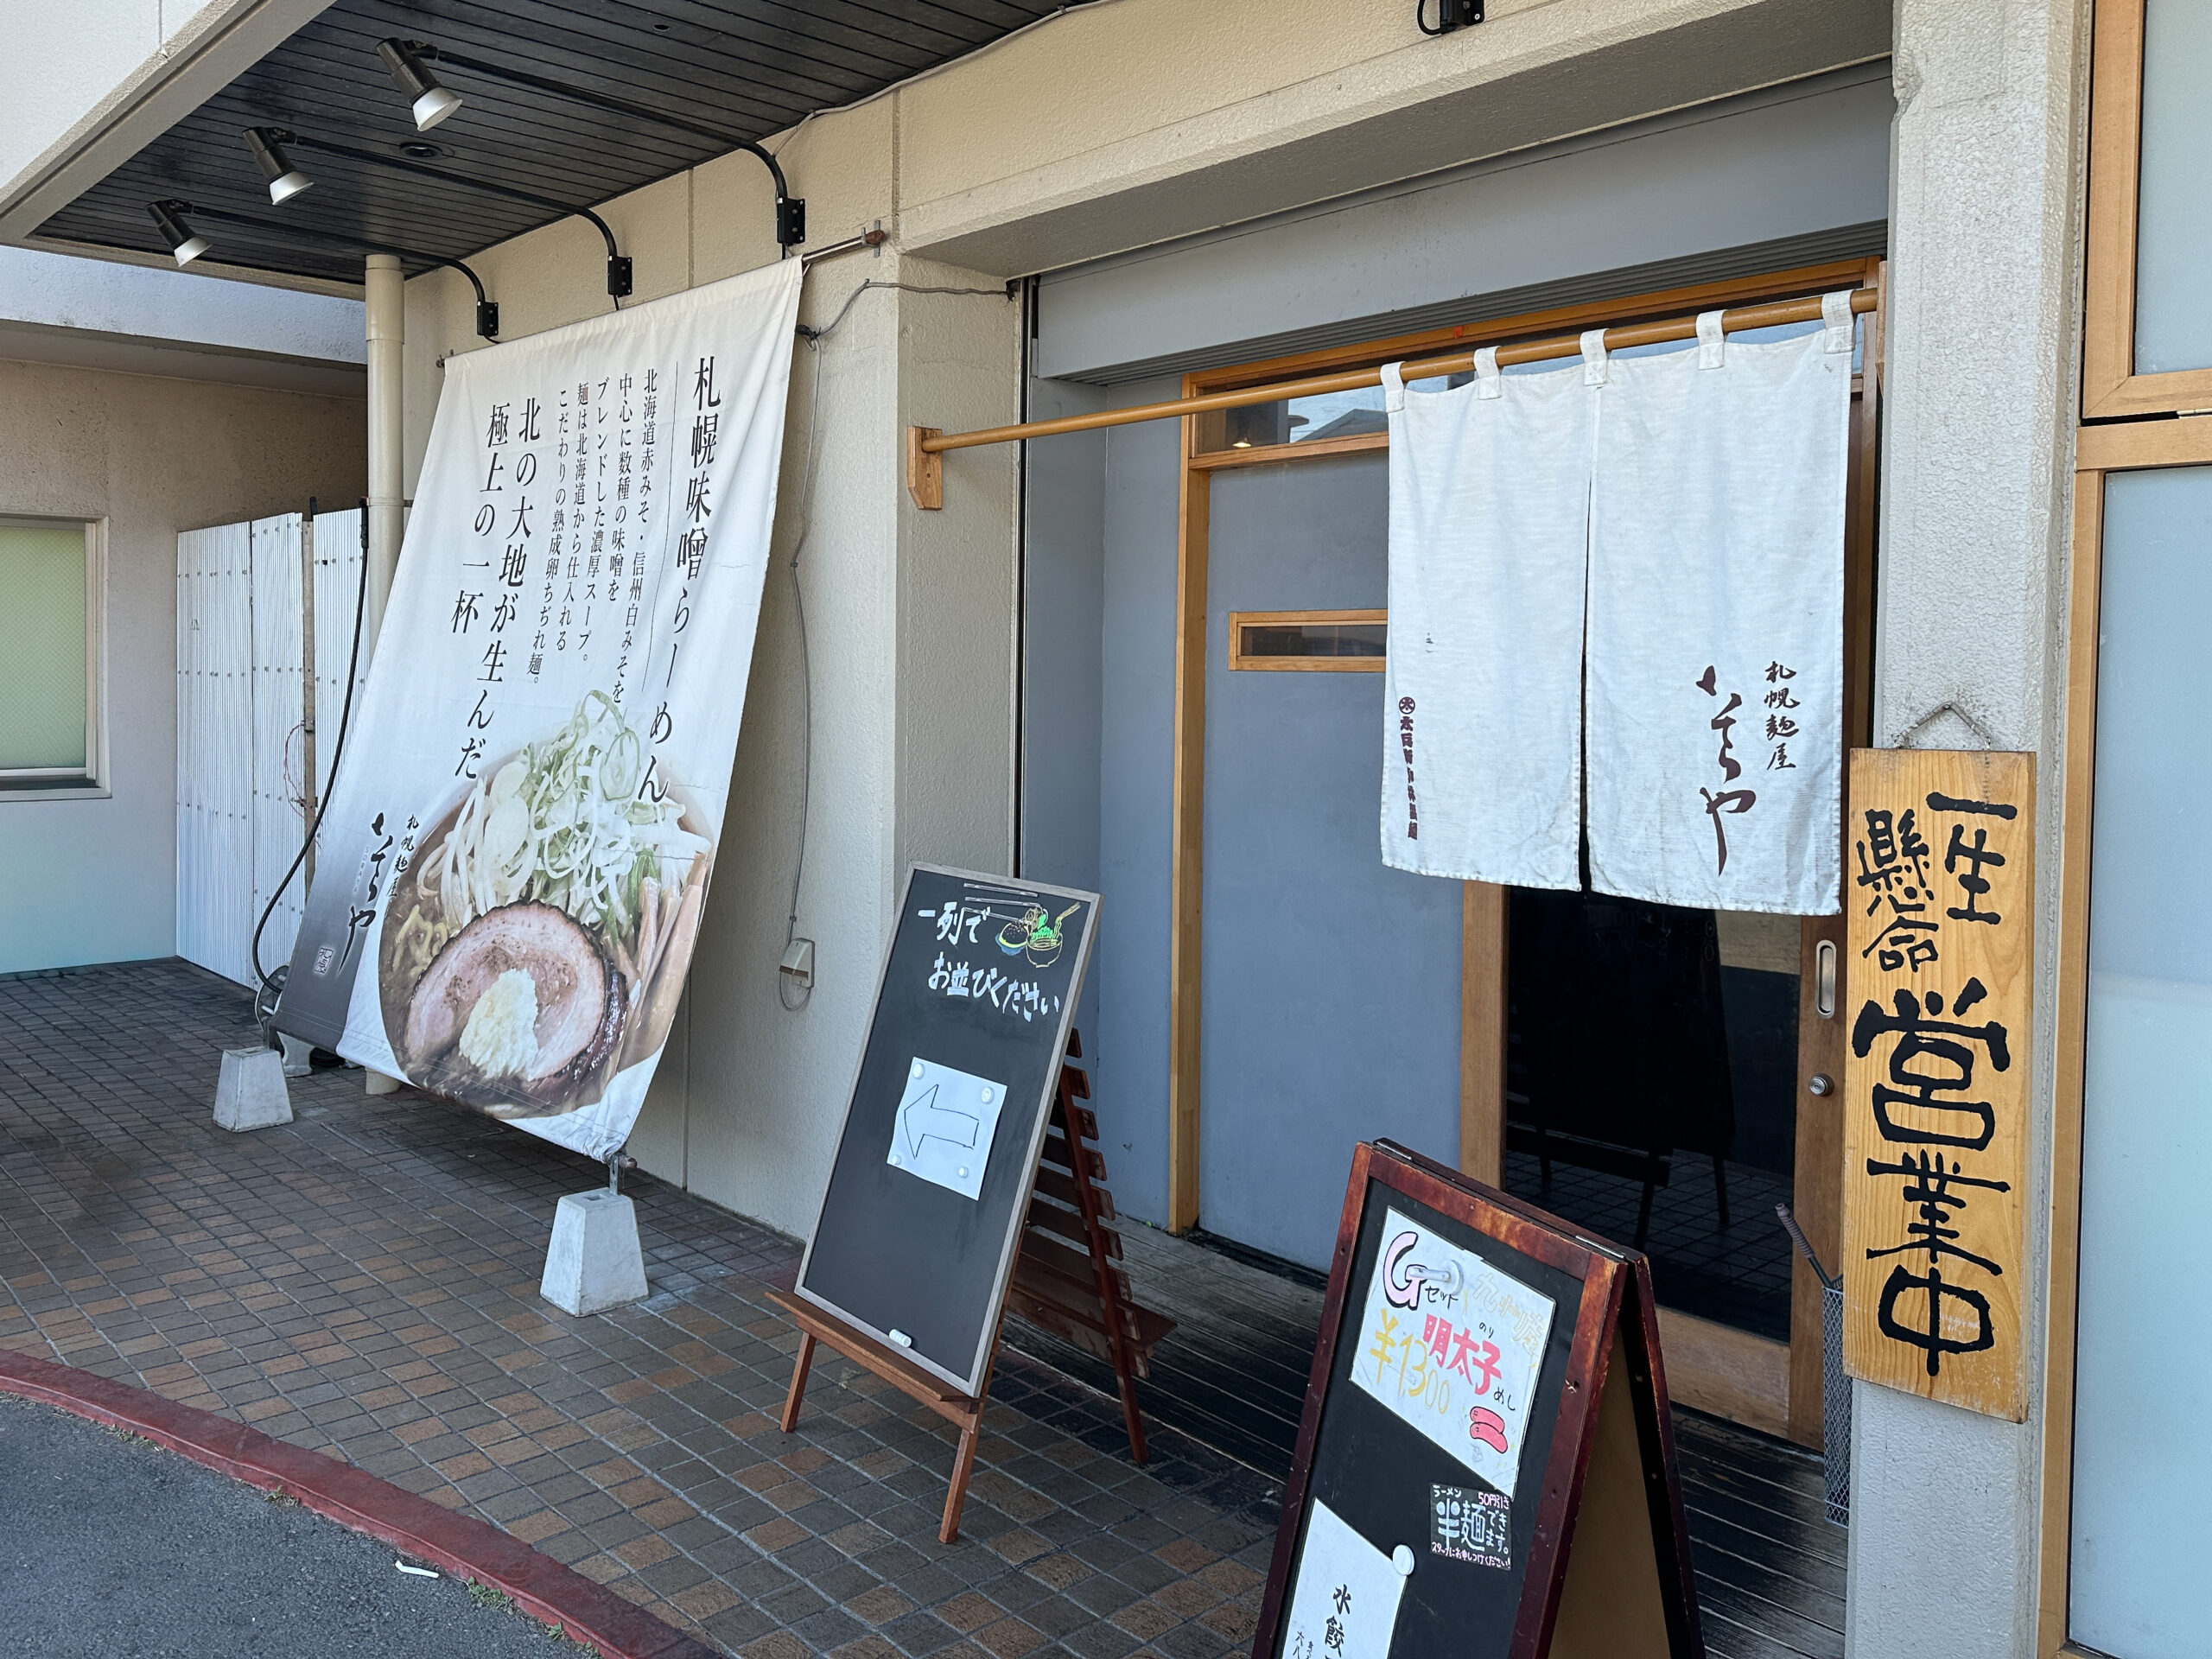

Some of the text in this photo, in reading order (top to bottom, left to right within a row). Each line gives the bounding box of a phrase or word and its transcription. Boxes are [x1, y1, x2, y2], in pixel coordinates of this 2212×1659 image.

[451, 403, 511, 633] 極上の一杯
[526, 390, 568, 683] こだわりの熟成卵ちぢれ麺。
[556, 382, 588, 652] 麺は北海道から仕入れる
[578, 377, 609, 662] ブレンドした濃厚スープ。
[607, 373, 632, 601] 中心に数種の味噌を
[612, 369, 657, 702] 北海道赤みそ・信州白みそを
[454, 397, 541, 779] 北の大地が生んだ
[638, 356, 721, 802] 札幌味噌らーめん
[918, 901, 991, 945] 一列で
[928, 951, 1059, 1021] お並びください
[1852, 976, 2012, 1376] 営業中
[1422, 1313, 1503, 1395] 明太子
[1478, 1321, 1495, 1338] のり
[1493, 1388, 1516, 1411] めし
[1433, 1484, 1462, 1498] ラーメン
[1436, 1498, 1486, 1552] 半麺
[1478, 1491, 1510, 1510] 50円引き
[1324, 1583, 1352, 1659] 水餃
